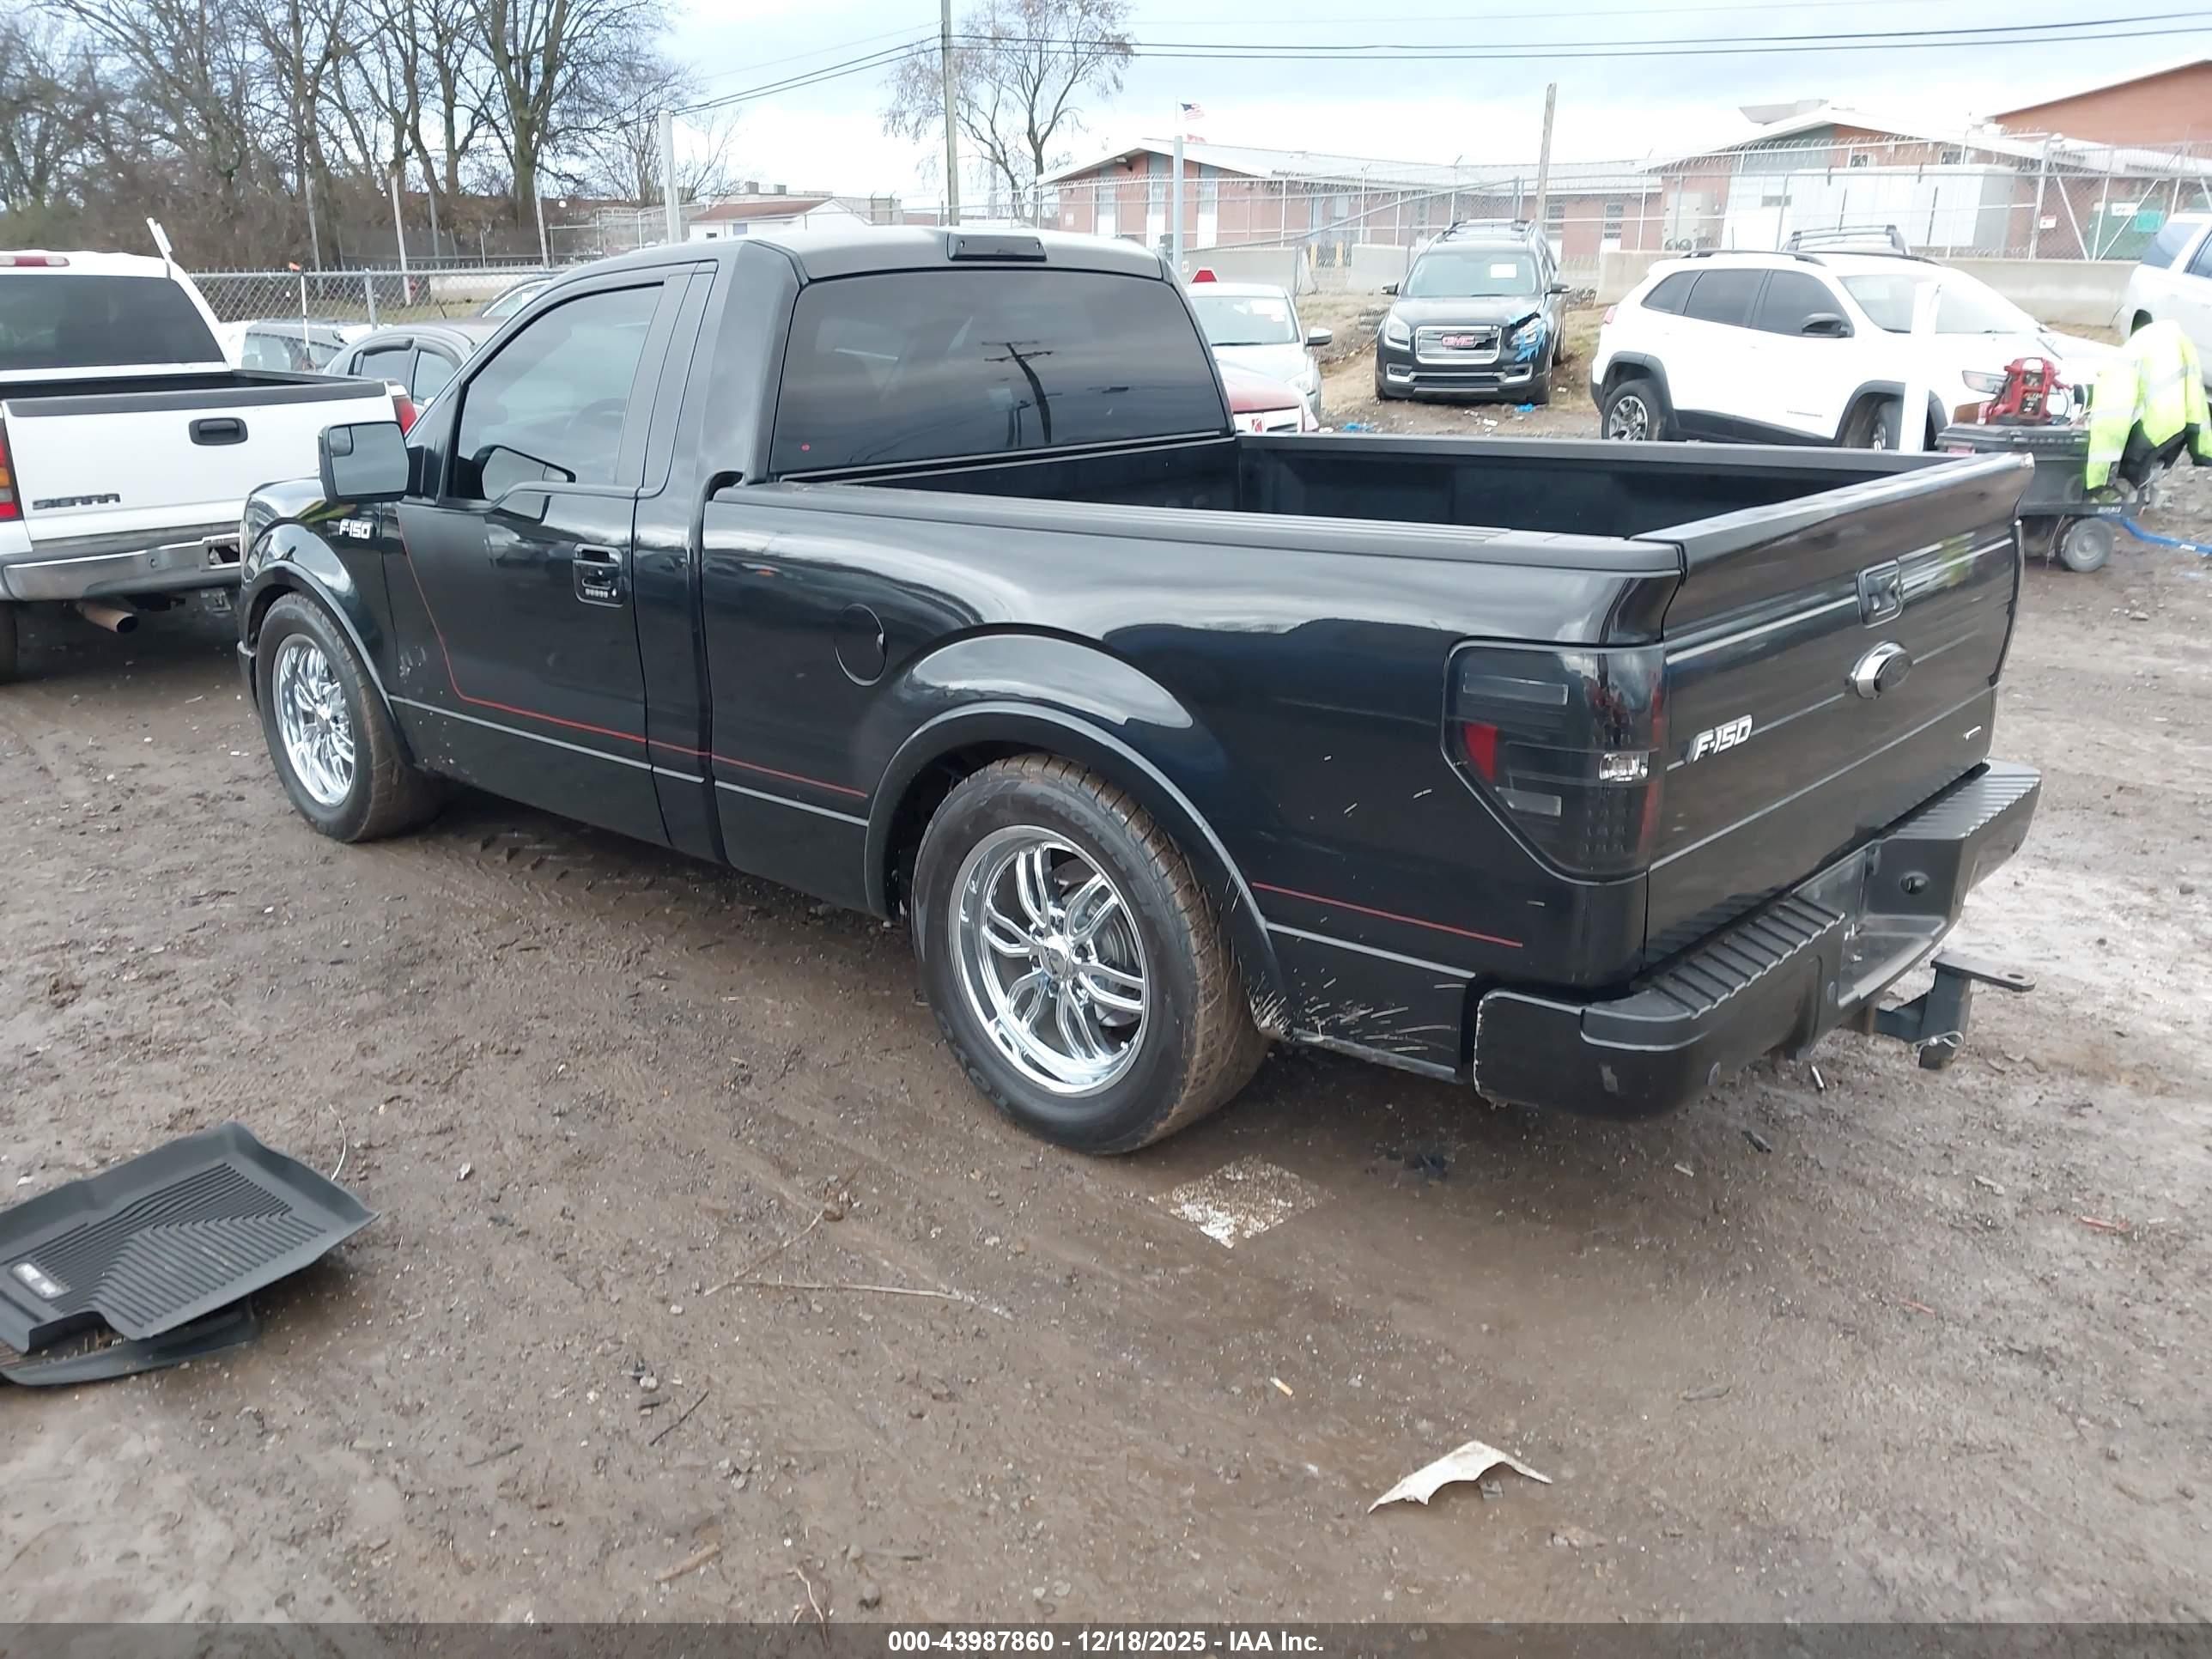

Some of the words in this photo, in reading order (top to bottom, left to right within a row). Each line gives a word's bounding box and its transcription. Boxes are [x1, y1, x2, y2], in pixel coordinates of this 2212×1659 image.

[1443, 336, 1475, 347] GMC
[33, 494, 120, 510] SIERRA
[339, 518, 373, 539] F-150
[1692, 714, 1753, 763] F-150
